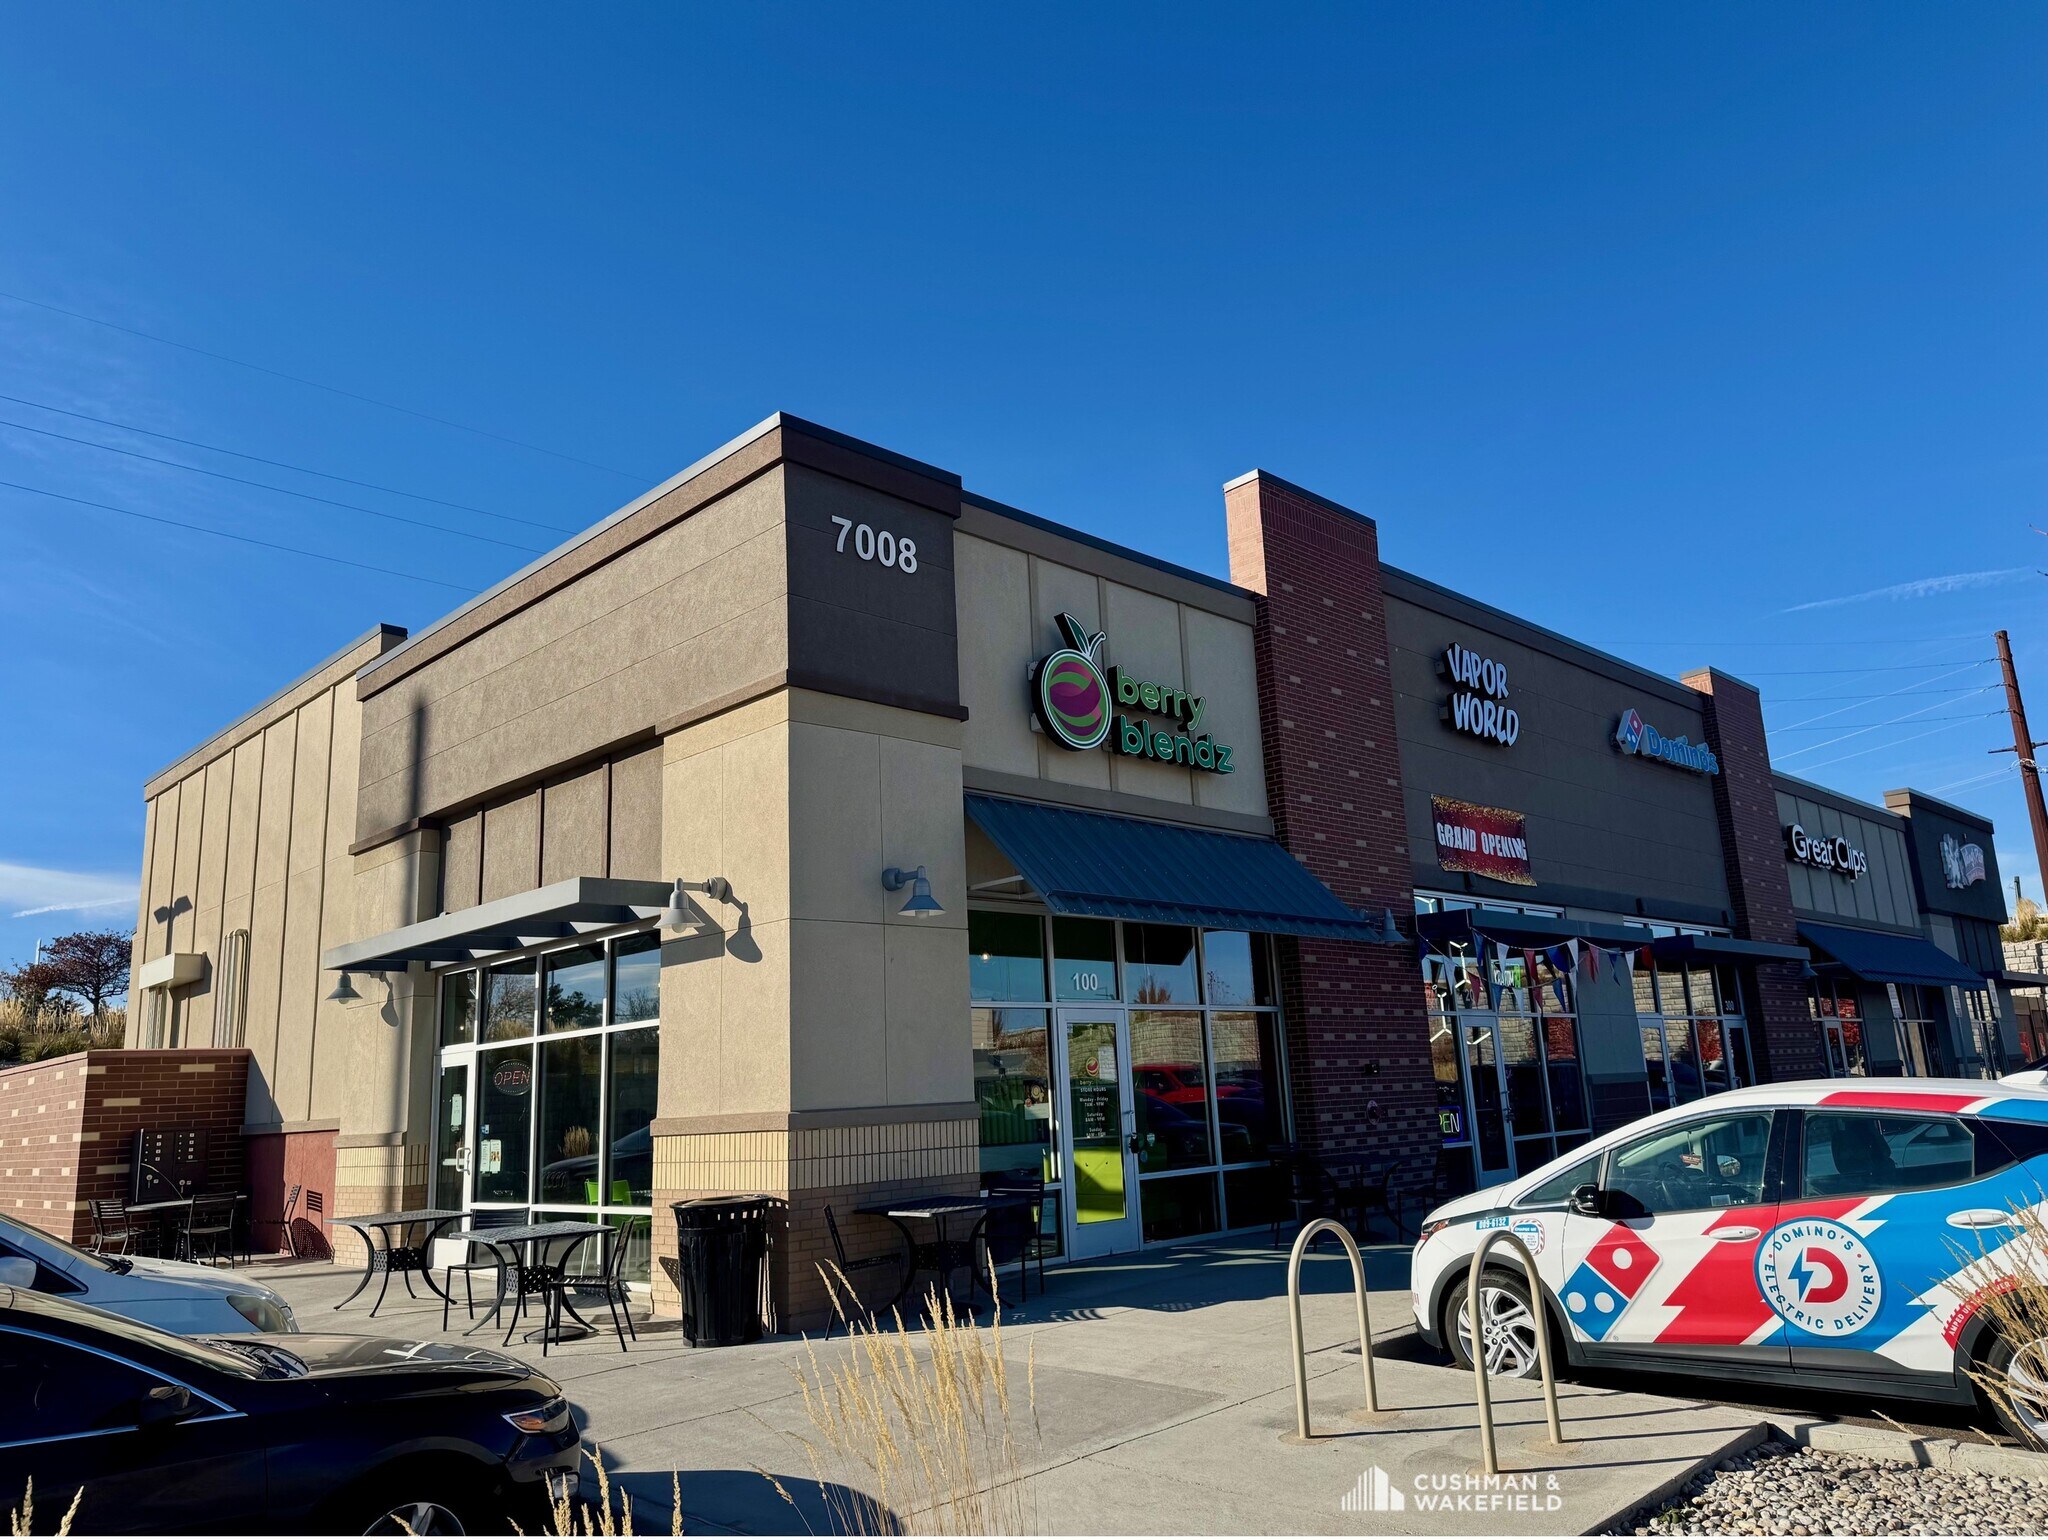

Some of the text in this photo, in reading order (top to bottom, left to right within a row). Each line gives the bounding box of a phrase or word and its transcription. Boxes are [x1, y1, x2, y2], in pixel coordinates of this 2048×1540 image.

[831, 515, 918, 574] 7008
[1446, 643, 1509, 699] VAPOR
[1114, 664, 1207, 732] berry
[1453, 692, 1519, 747] WORLD
[1118, 715, 1236, 775] blendz
[1436, 822, 1528, 861] GRAND OPENING
[1792, 824, 1867, 880] Great Clips
[1072, 972, 1098, 991] 100
[1465, 989, 1475, 1001] 20
[494, 1070, 531, 1086] OPEN
[1439, 1113, 1460, 1133] EN
[1772, 1226, 1854, 1251] DOMINO'S
[1764, 1263, 1875, 1330] ELECTRIC DELIVERY
[1949, 1313, 1965, 1336] AMPED
